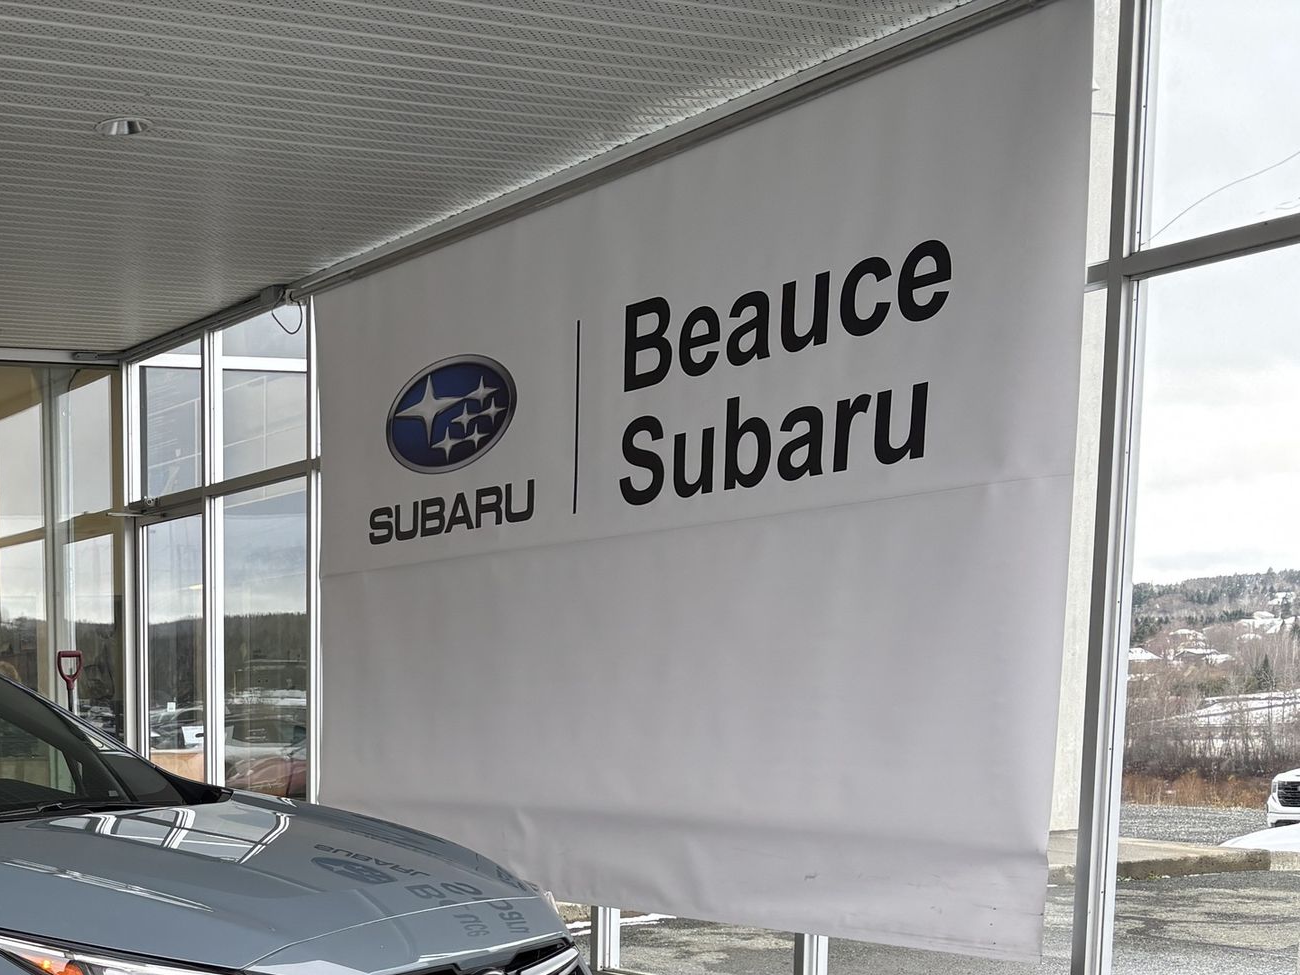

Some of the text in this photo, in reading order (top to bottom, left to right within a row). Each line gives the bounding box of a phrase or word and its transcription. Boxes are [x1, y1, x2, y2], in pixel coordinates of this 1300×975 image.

[624, 240, 952, 393] Beauce
[619, 382, 929, 506] Subaru
[369, 479, 535, 545] SUBARU
